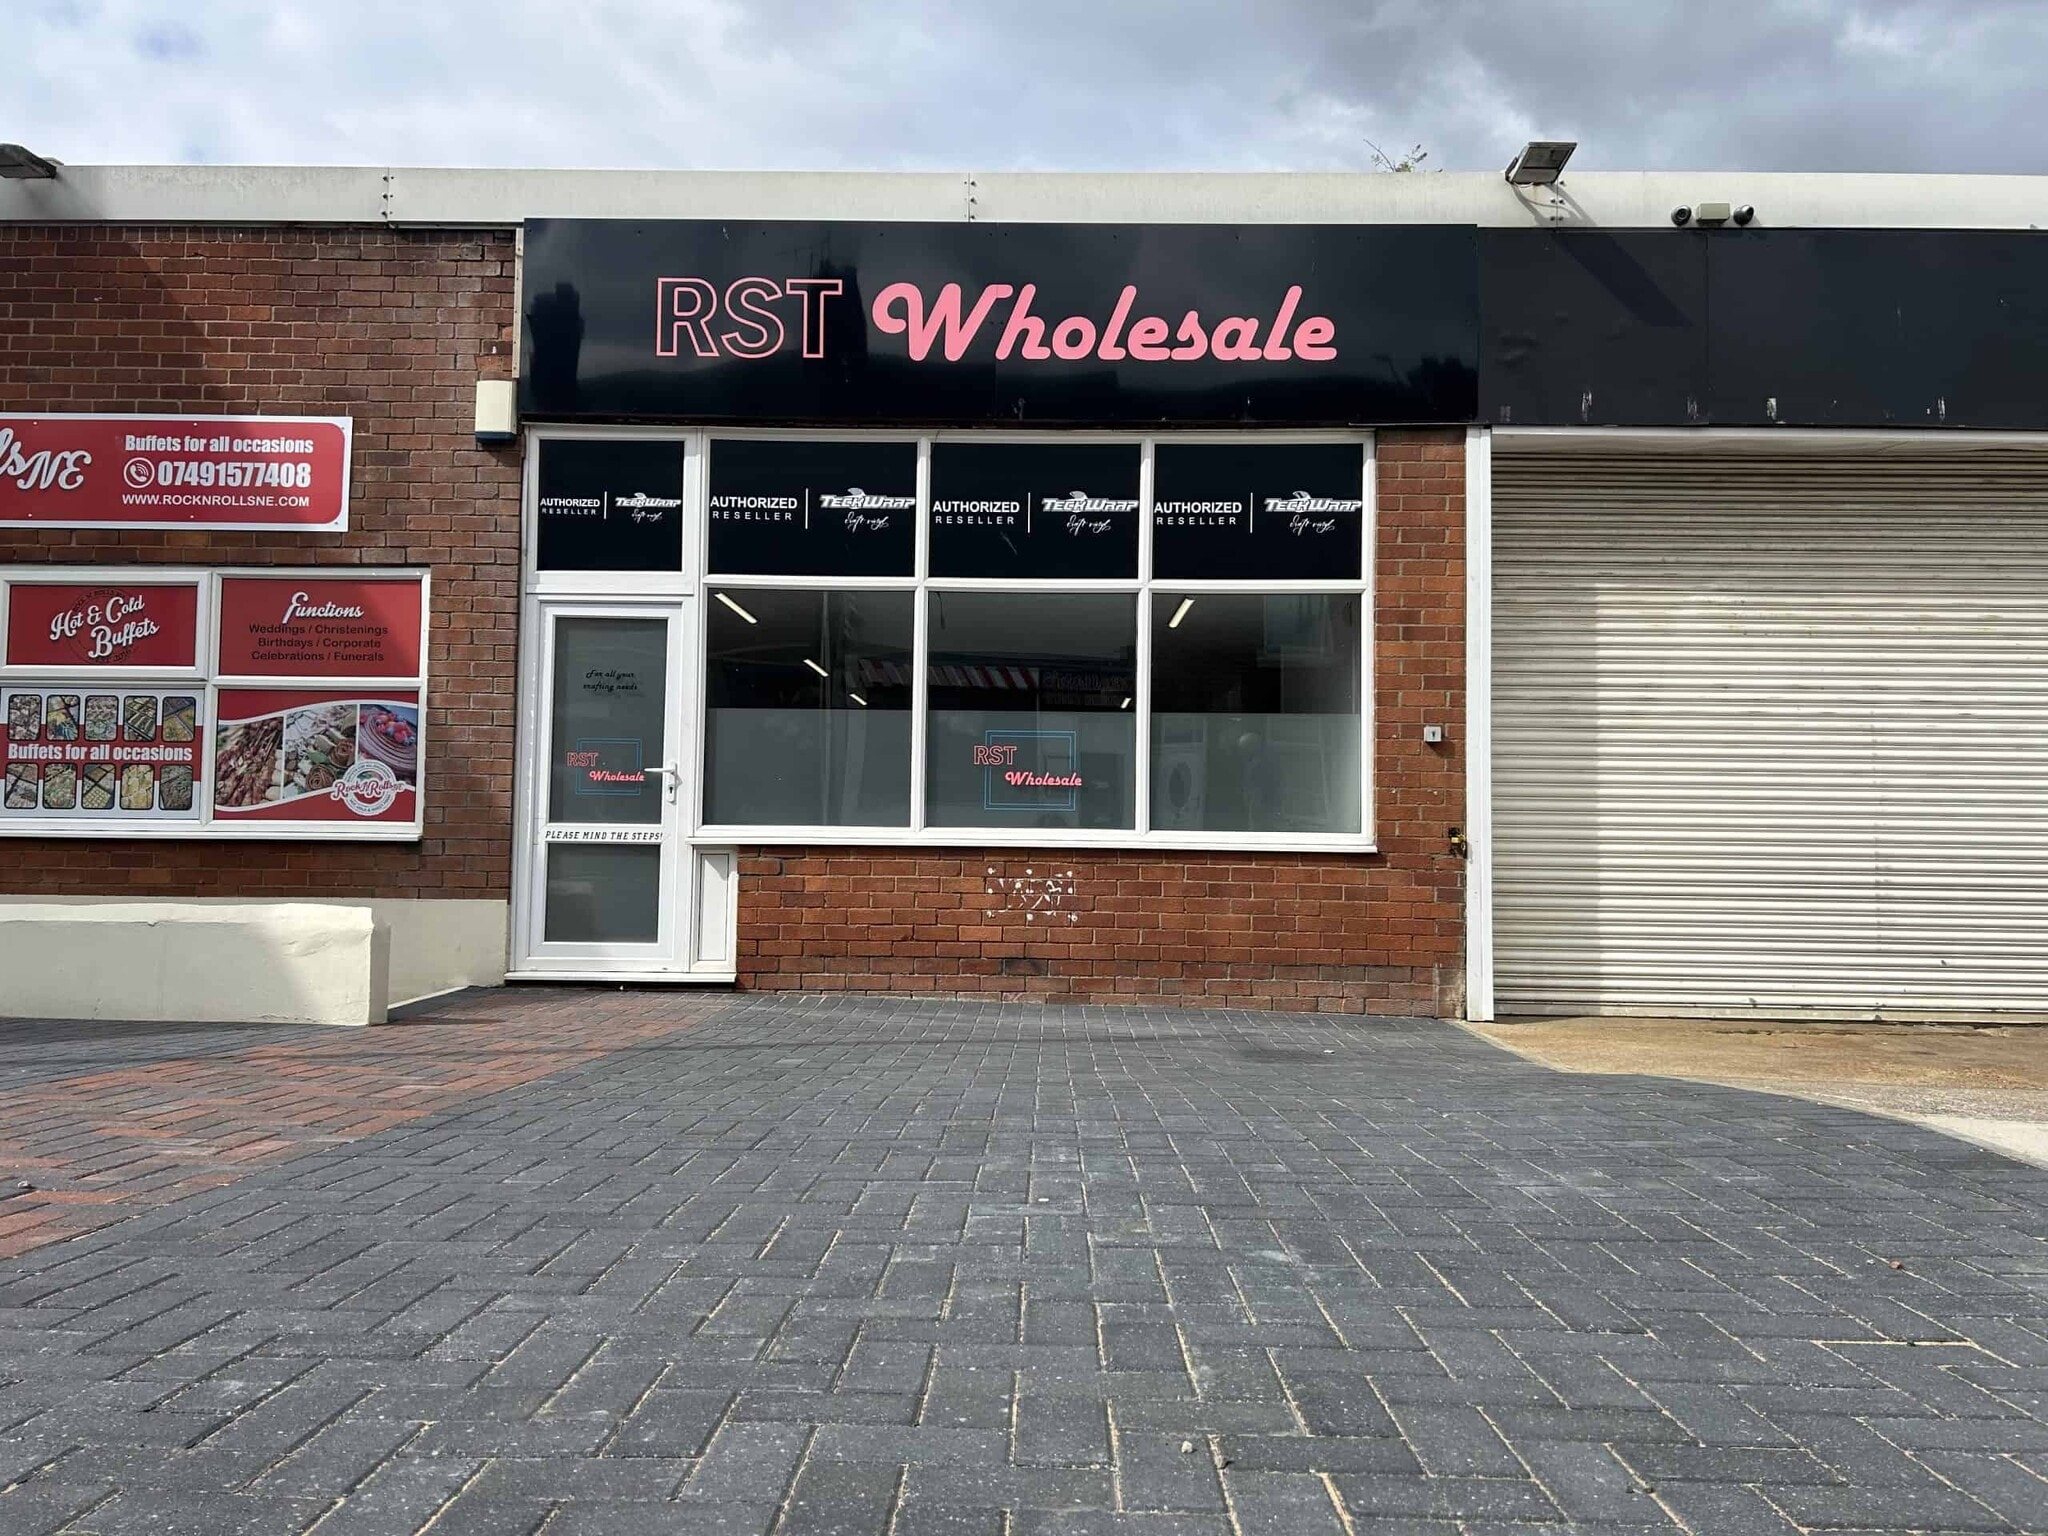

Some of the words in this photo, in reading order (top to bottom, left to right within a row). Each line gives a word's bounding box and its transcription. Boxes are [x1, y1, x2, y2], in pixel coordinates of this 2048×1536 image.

[655, 277, 843, 359] RST
[872, 281, 1338, 362] Wholesale
[125, 434, 181, 453] Buffets
[184, 435, 208, 453] for
[210, 435, 229, 453] all
[233, 436, 314, 454] occasions
[157, 461, 312, 488] 07491577408
[122, 493, 310, 508] WWW.ROCKNROLLSNE.COM
[539, 497, 601, 507] AUTHORIZED
[710, 496, 798, 508] AUTHORIZED
[932, 501, 1020, 513] AUTHORIZED
[1153, 501, 1243, 513] AUTHORIZED
[541, 507, 597, 516] RESELLER
[712, 511, 793, 520] RESELLER
[935, 515, 1015, 524] RESELLER
[1156, 516, 1237, 525] RESELLER
[282, 591, 364, 624] Functions
[49, 610, 84, 641] Hot
[87, 605, 102, 625] &
[105, 595, 145, 624] Cold
[249, 623, 306, 636] Weddings
[315, 624, 389, 636] Christenings
[88, 617, 160, 658] Buffets
[258, 637, 314, 649] Birthdays
[322, 638, 382, 650] Corporate
[251, 650, 325, 661] Celebrations
[333, 650, 385, 662] Funerals
[604, 670, 616, 678] all
[7, 743, 62, 761] Buffets
[65, 744, 88, 761] for
[90, 744, 110, 761] all
[113, 745, 192, 762] occasions
[973, 745, 1017, 765] RST
[566, 752, 599, 767] RST
[589, 770, 646, 782] Wholesale
[1005, 771, 1082, 786] Wholesale
[545, 830, 579, 840] PLEASE
[582, 831, 607, 840] MIND
[610, 831, 629, 840] THE
[631, 831, 664, 841] STEPS!
